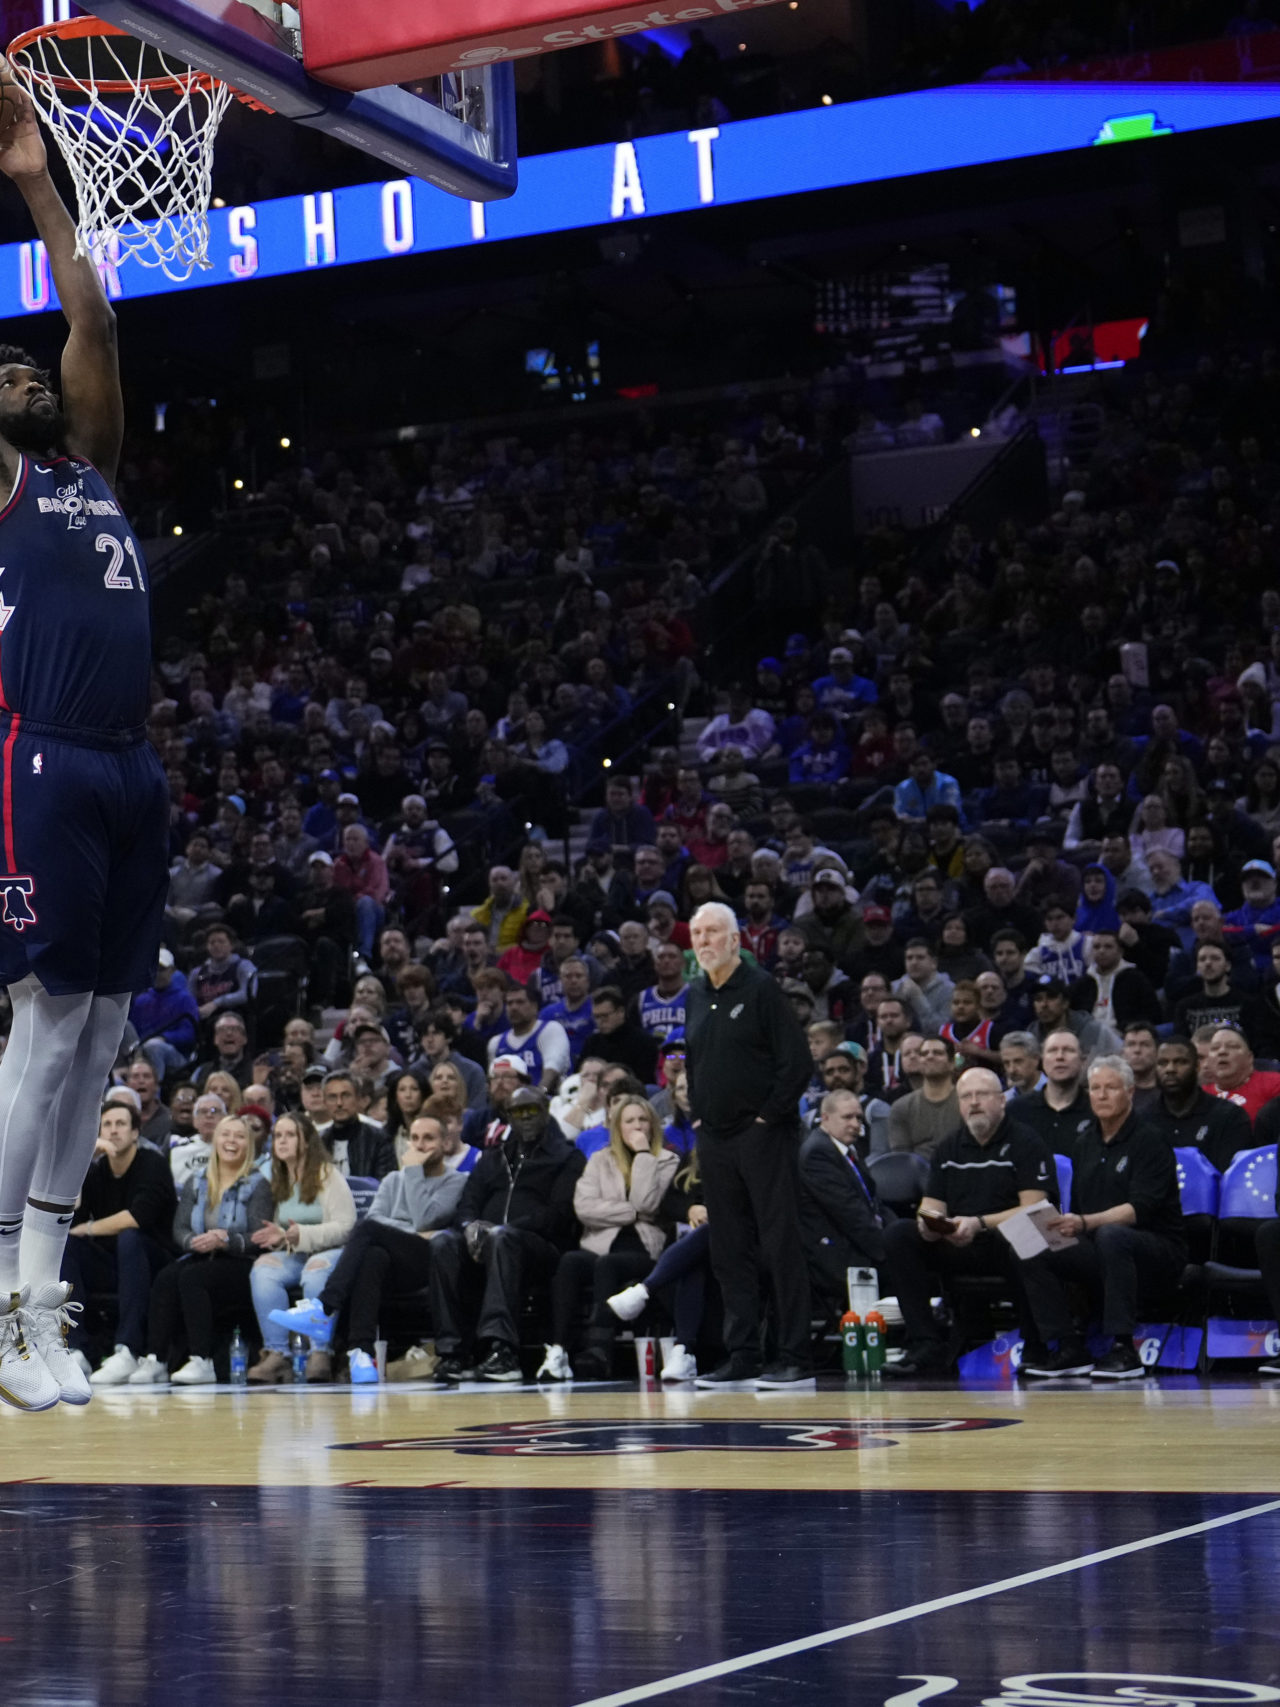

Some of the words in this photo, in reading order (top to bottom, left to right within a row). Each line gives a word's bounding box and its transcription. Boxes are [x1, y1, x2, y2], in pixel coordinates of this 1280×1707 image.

[542, 7, 714, 47] State
[611, 128, 720, 218] AT
[95, 532, 145, 592] 21
[845, 1331, 858, 1347] G
[866, 1331, 879, 1347] G
